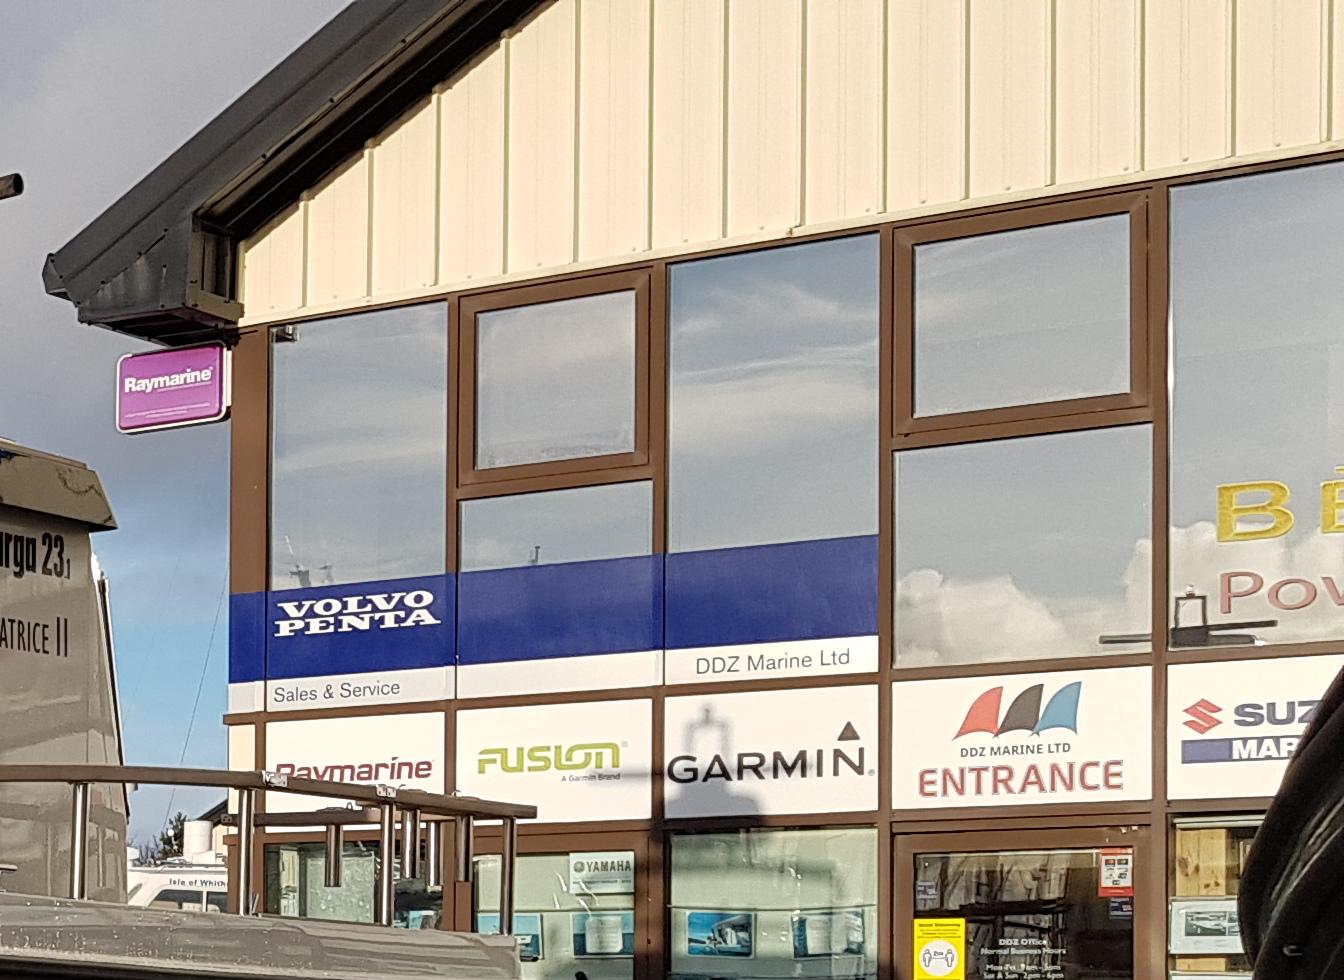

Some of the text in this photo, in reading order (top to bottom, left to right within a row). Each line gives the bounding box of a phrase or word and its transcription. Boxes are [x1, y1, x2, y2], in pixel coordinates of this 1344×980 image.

[124, 367, 212, 393] Raymarine
[276, 590, 434, 618] VOLVO
[274, 608, 442, 637] PENTA
[56, 616, 68, 658] II
[696, 648, 851, 675] DDZ Marine Ltd
[273, 680, 401, 703] Sales & Service
[960, 742, 1071, 758] DDZ MARINE LTD
[598, 773, 621, 781] Brand
[667, 747, 865, 784] GARMIN
[918, 759, 1124, 798] ENTRANCE
[586, 860, 632, 873] YAMAHA
[169, 878, 228, 887] Isle of Whith
